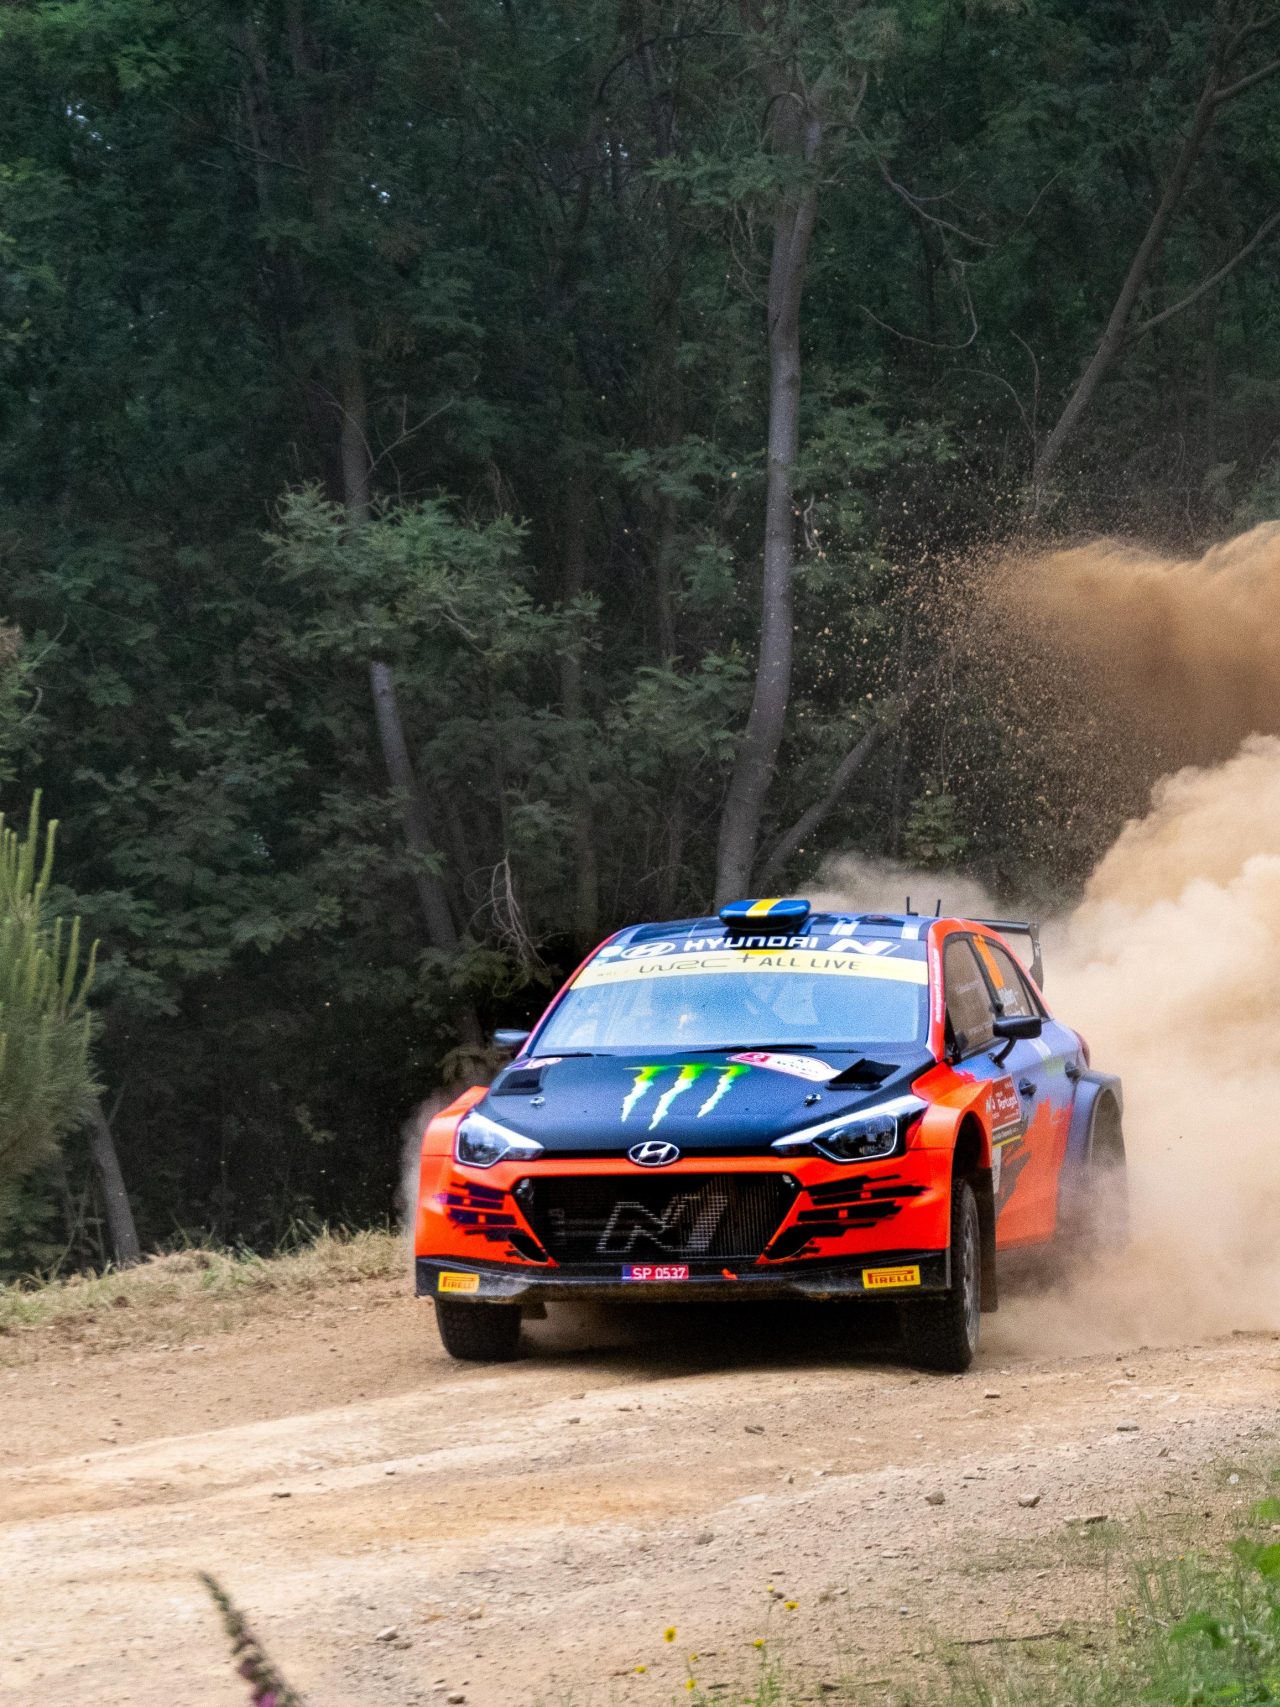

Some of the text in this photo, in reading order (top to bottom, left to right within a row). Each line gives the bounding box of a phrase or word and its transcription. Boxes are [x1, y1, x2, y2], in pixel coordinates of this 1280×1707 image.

[685, 936, 818, 951] HYUNDAI
[759, 956, 801, 968] ALL
[810, 958, 863, 971] LIVE
[632, 1267, 685, 1280] SP 0537
[867, 1269, 915, 1285] PIRELLI
[442, 1276, 476, 1289] PIRELLI
